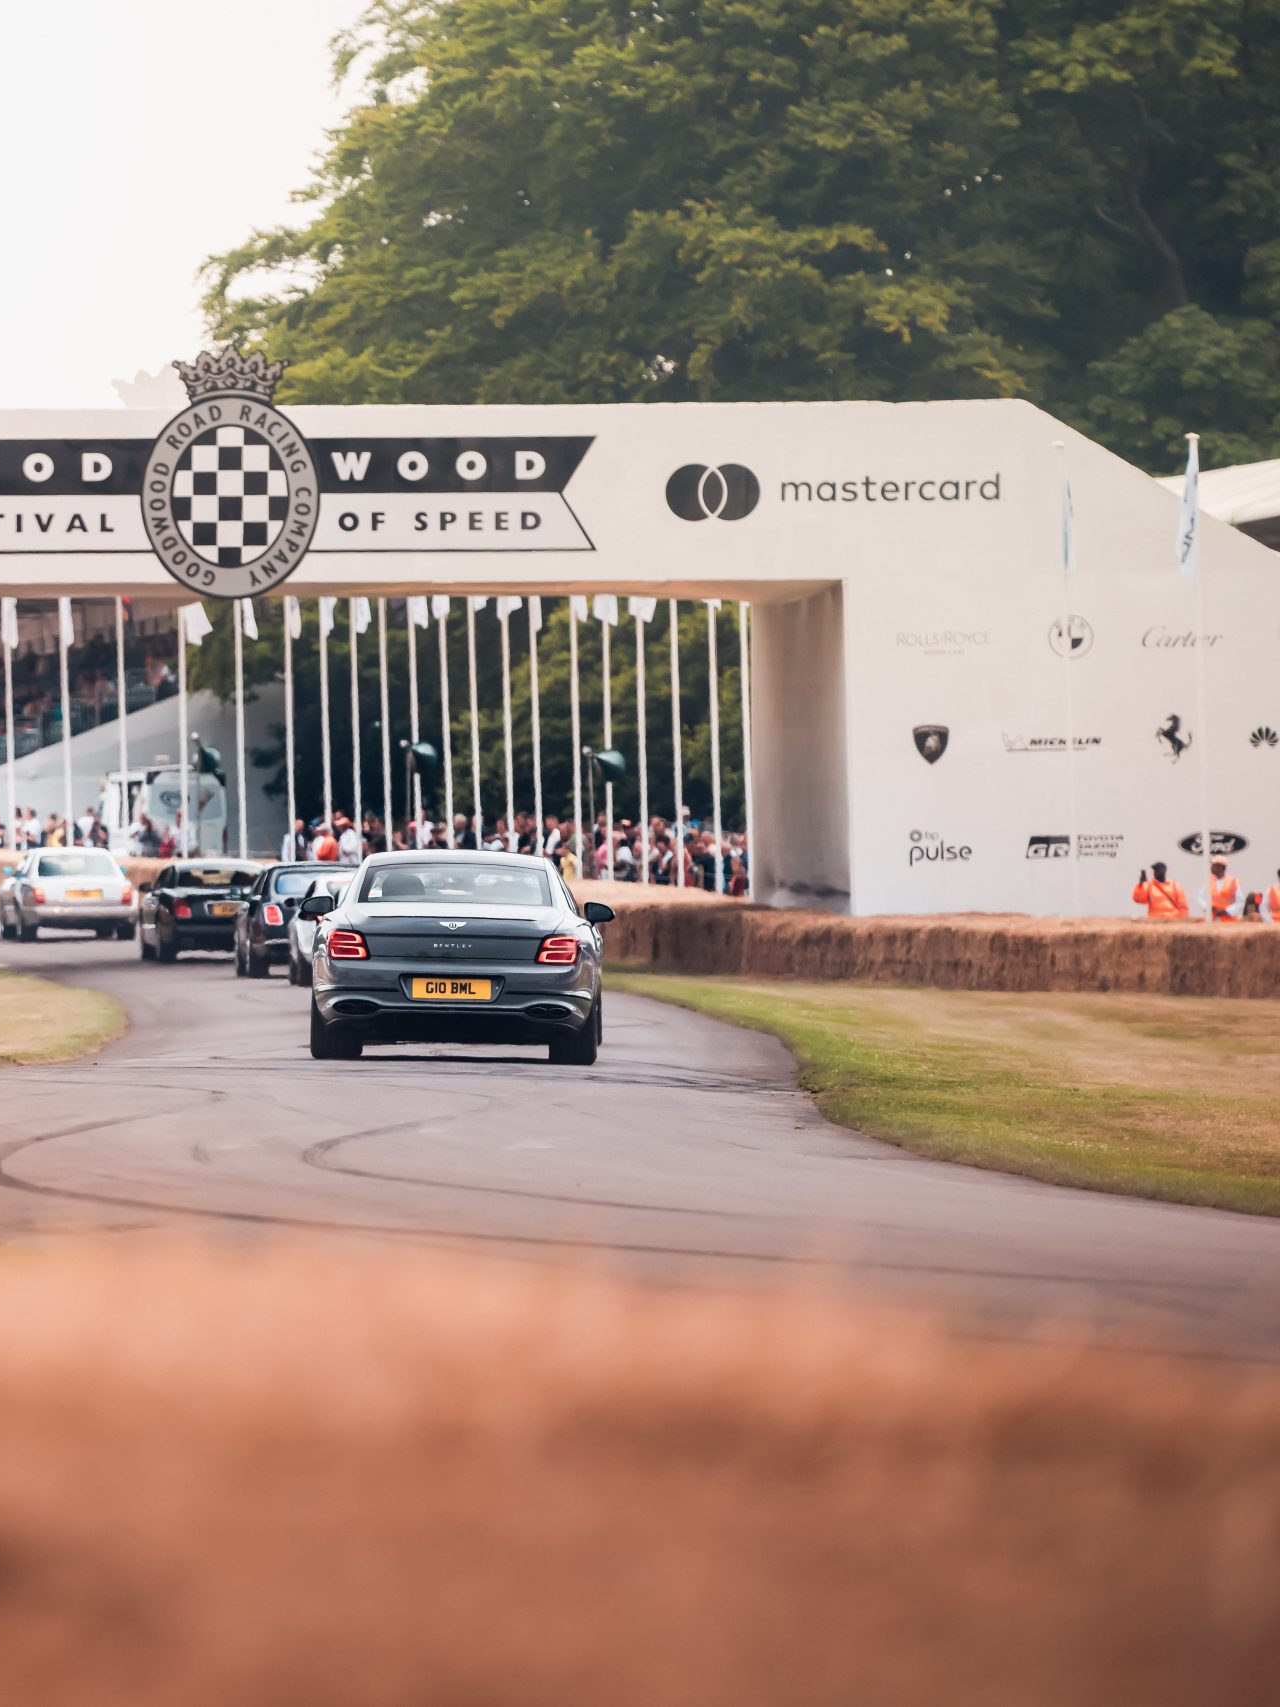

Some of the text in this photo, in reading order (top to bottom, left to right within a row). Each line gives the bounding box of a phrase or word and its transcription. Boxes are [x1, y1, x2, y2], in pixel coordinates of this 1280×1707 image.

[330, 450, 546, 481] WOOD
[150, 403, 312, 587] GOODWOOD ROAD RACING COMPANY
[781, 473, 1001, 502] mastercard
[338, 512, 386, 531] OF
[414, 511, 542, 531] SPEED
[909, 840, 972, 867] pulse
[450, 982, 477, 995] BML
